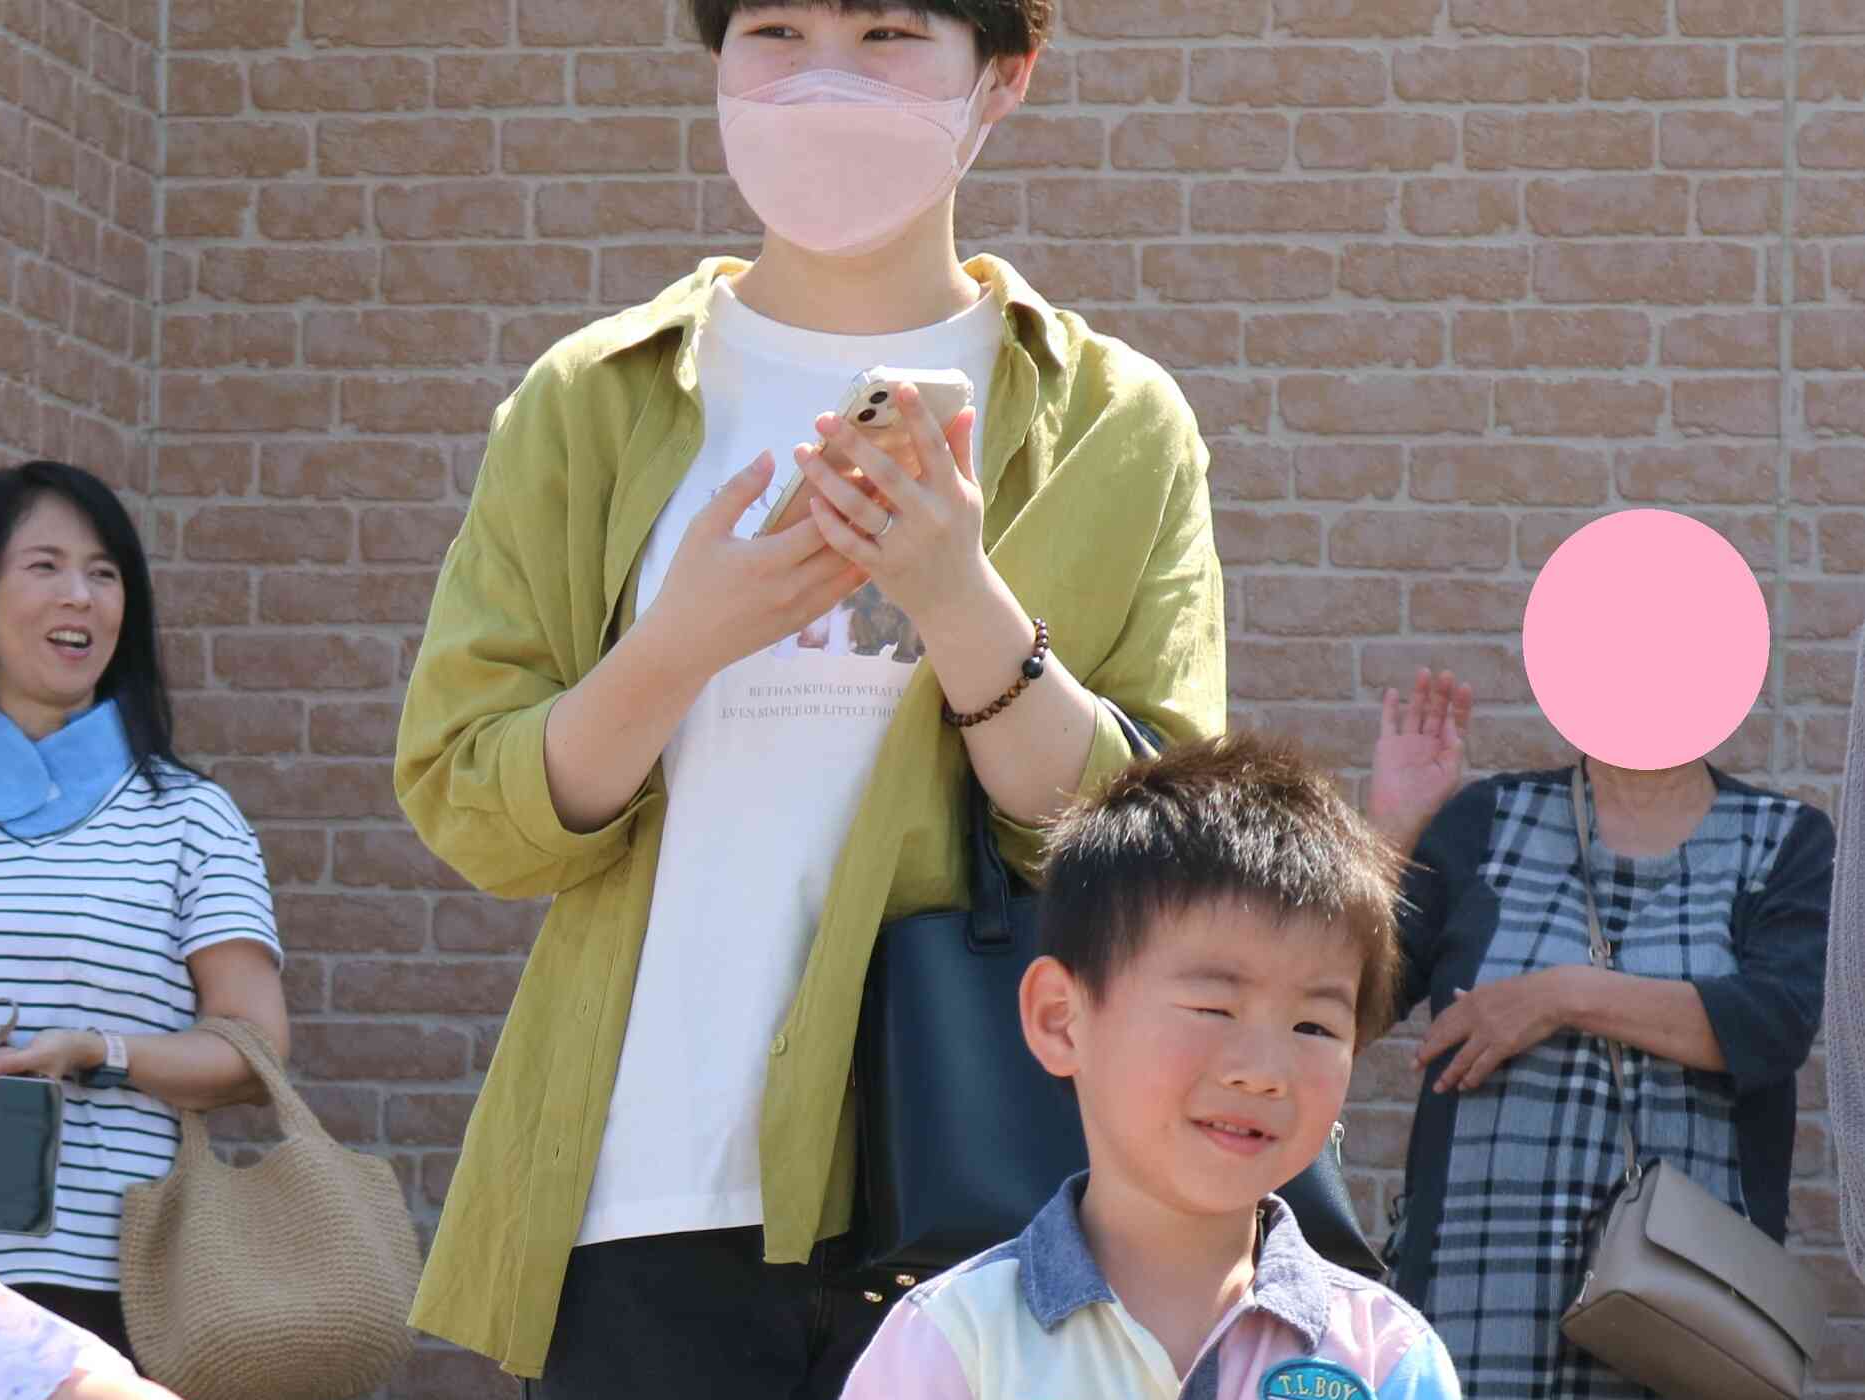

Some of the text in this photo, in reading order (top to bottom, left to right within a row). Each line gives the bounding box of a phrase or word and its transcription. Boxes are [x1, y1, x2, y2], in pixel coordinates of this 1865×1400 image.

[764, 683, 836, 697] THANKFUL
[856, 685, 894, 697] WHAT
[722, 706, 757, 719] EVEN
[758, 705, 801, 718] SIMPLE
[822, 704, 869, 717] LITTLE
